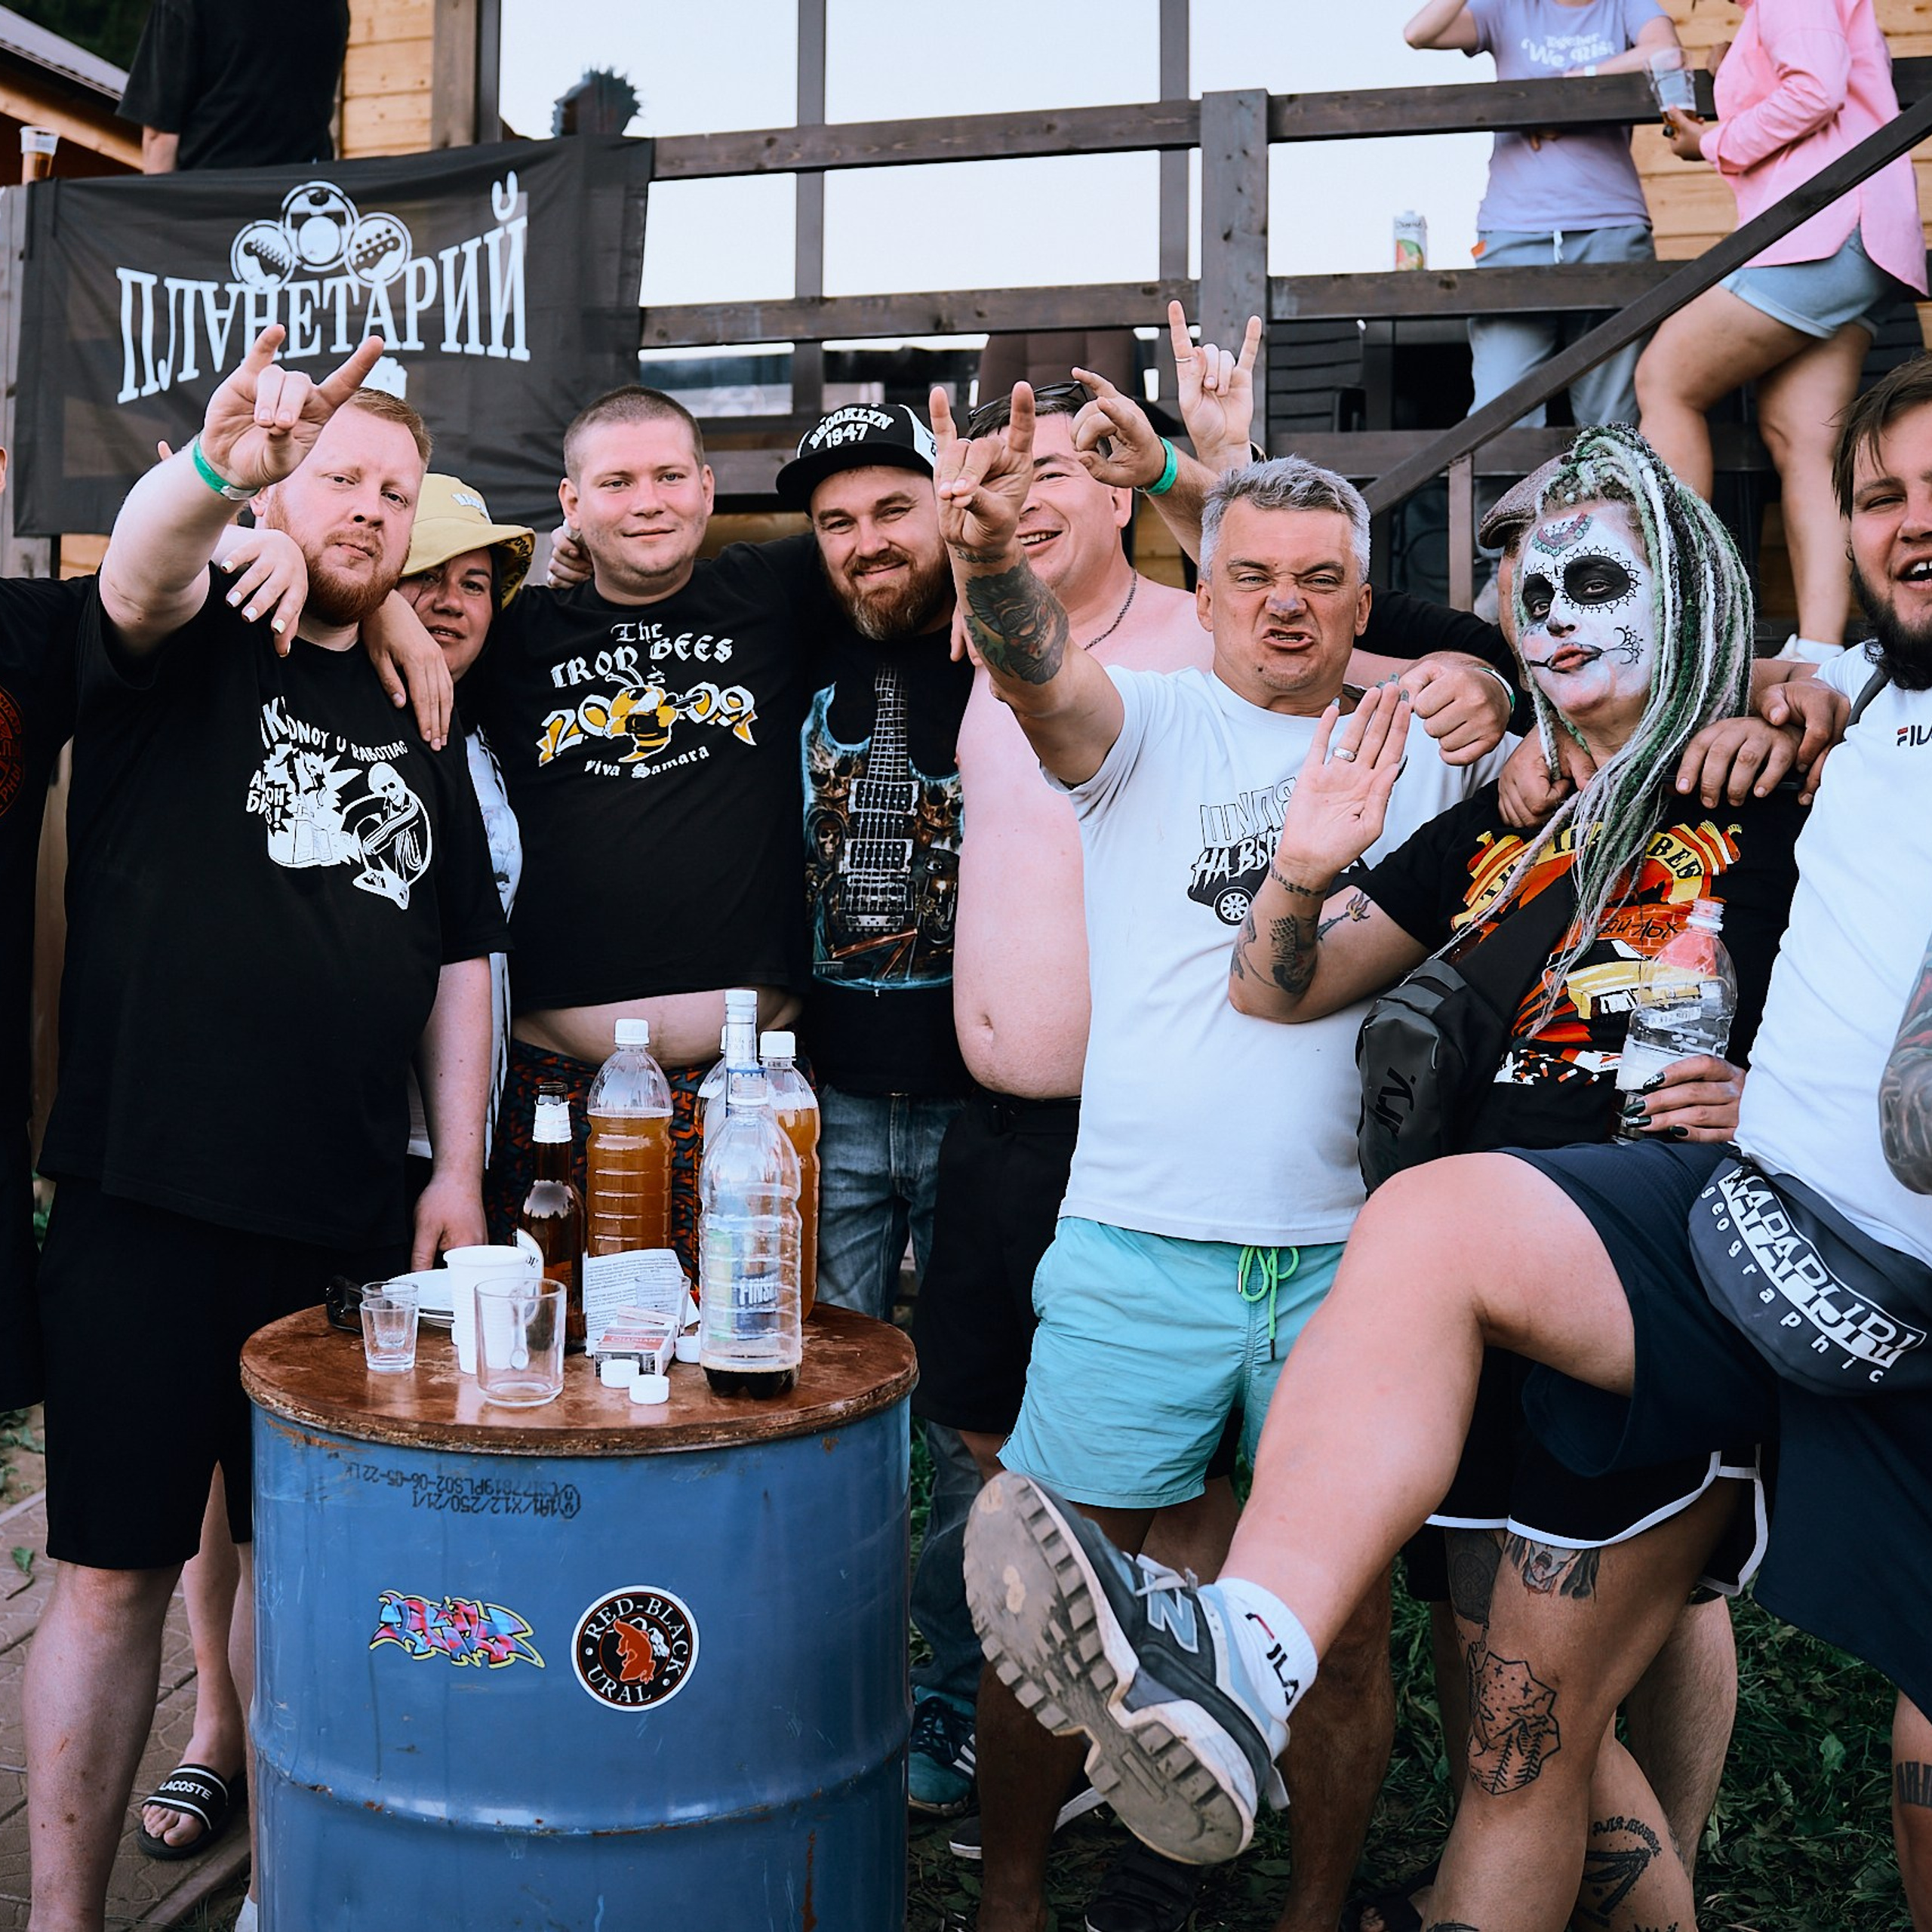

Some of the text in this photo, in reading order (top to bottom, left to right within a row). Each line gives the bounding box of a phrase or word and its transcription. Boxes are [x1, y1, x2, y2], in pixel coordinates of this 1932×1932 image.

[808, 408, 895, 449] BROOKLYN
[826, 423, 869, 448] 1947
[610, 620, 663, 643] The
[649, 632, 734, 663] BEES
[337, 736, 346, 752] U
[630, 746, 710, 779] Samara
[1701, 1186, 1884, 1383] geographic
[584, 1597, 689, 1676] RED-BLACK
[587, 1663, 651, 1703] URAL
[158, 1780, 213, 1801] LACOSTE
